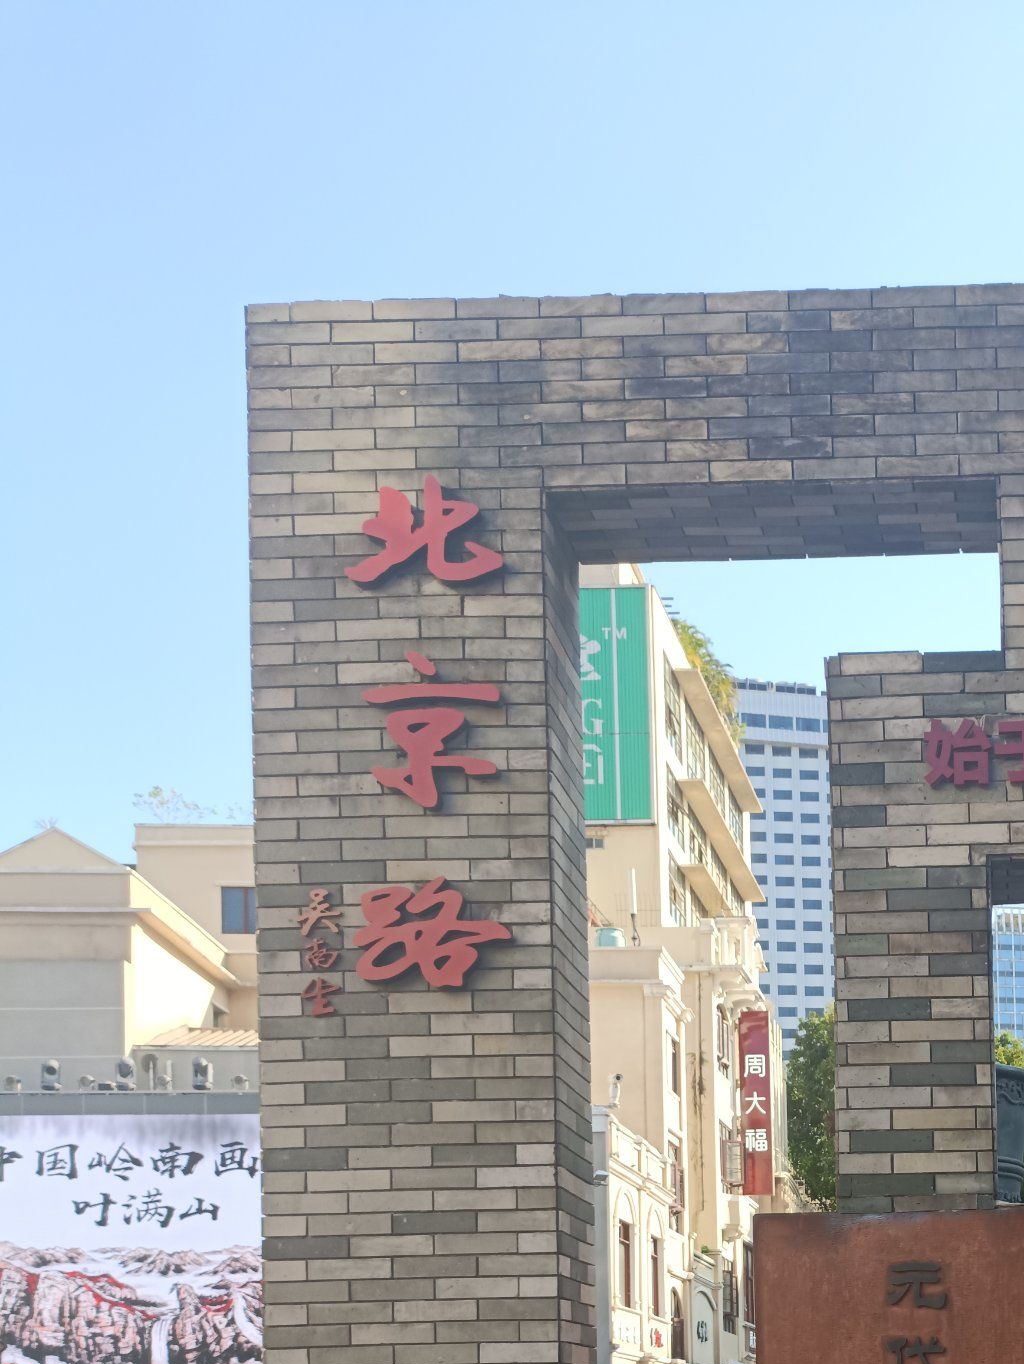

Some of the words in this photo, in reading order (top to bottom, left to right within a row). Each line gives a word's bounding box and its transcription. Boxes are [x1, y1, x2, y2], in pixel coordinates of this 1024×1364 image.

[344, 474, 512, 988] 北京路
[743, 1053, 768, 1152] 周大福
[72, 1188, 220, 1228] 叶满山
